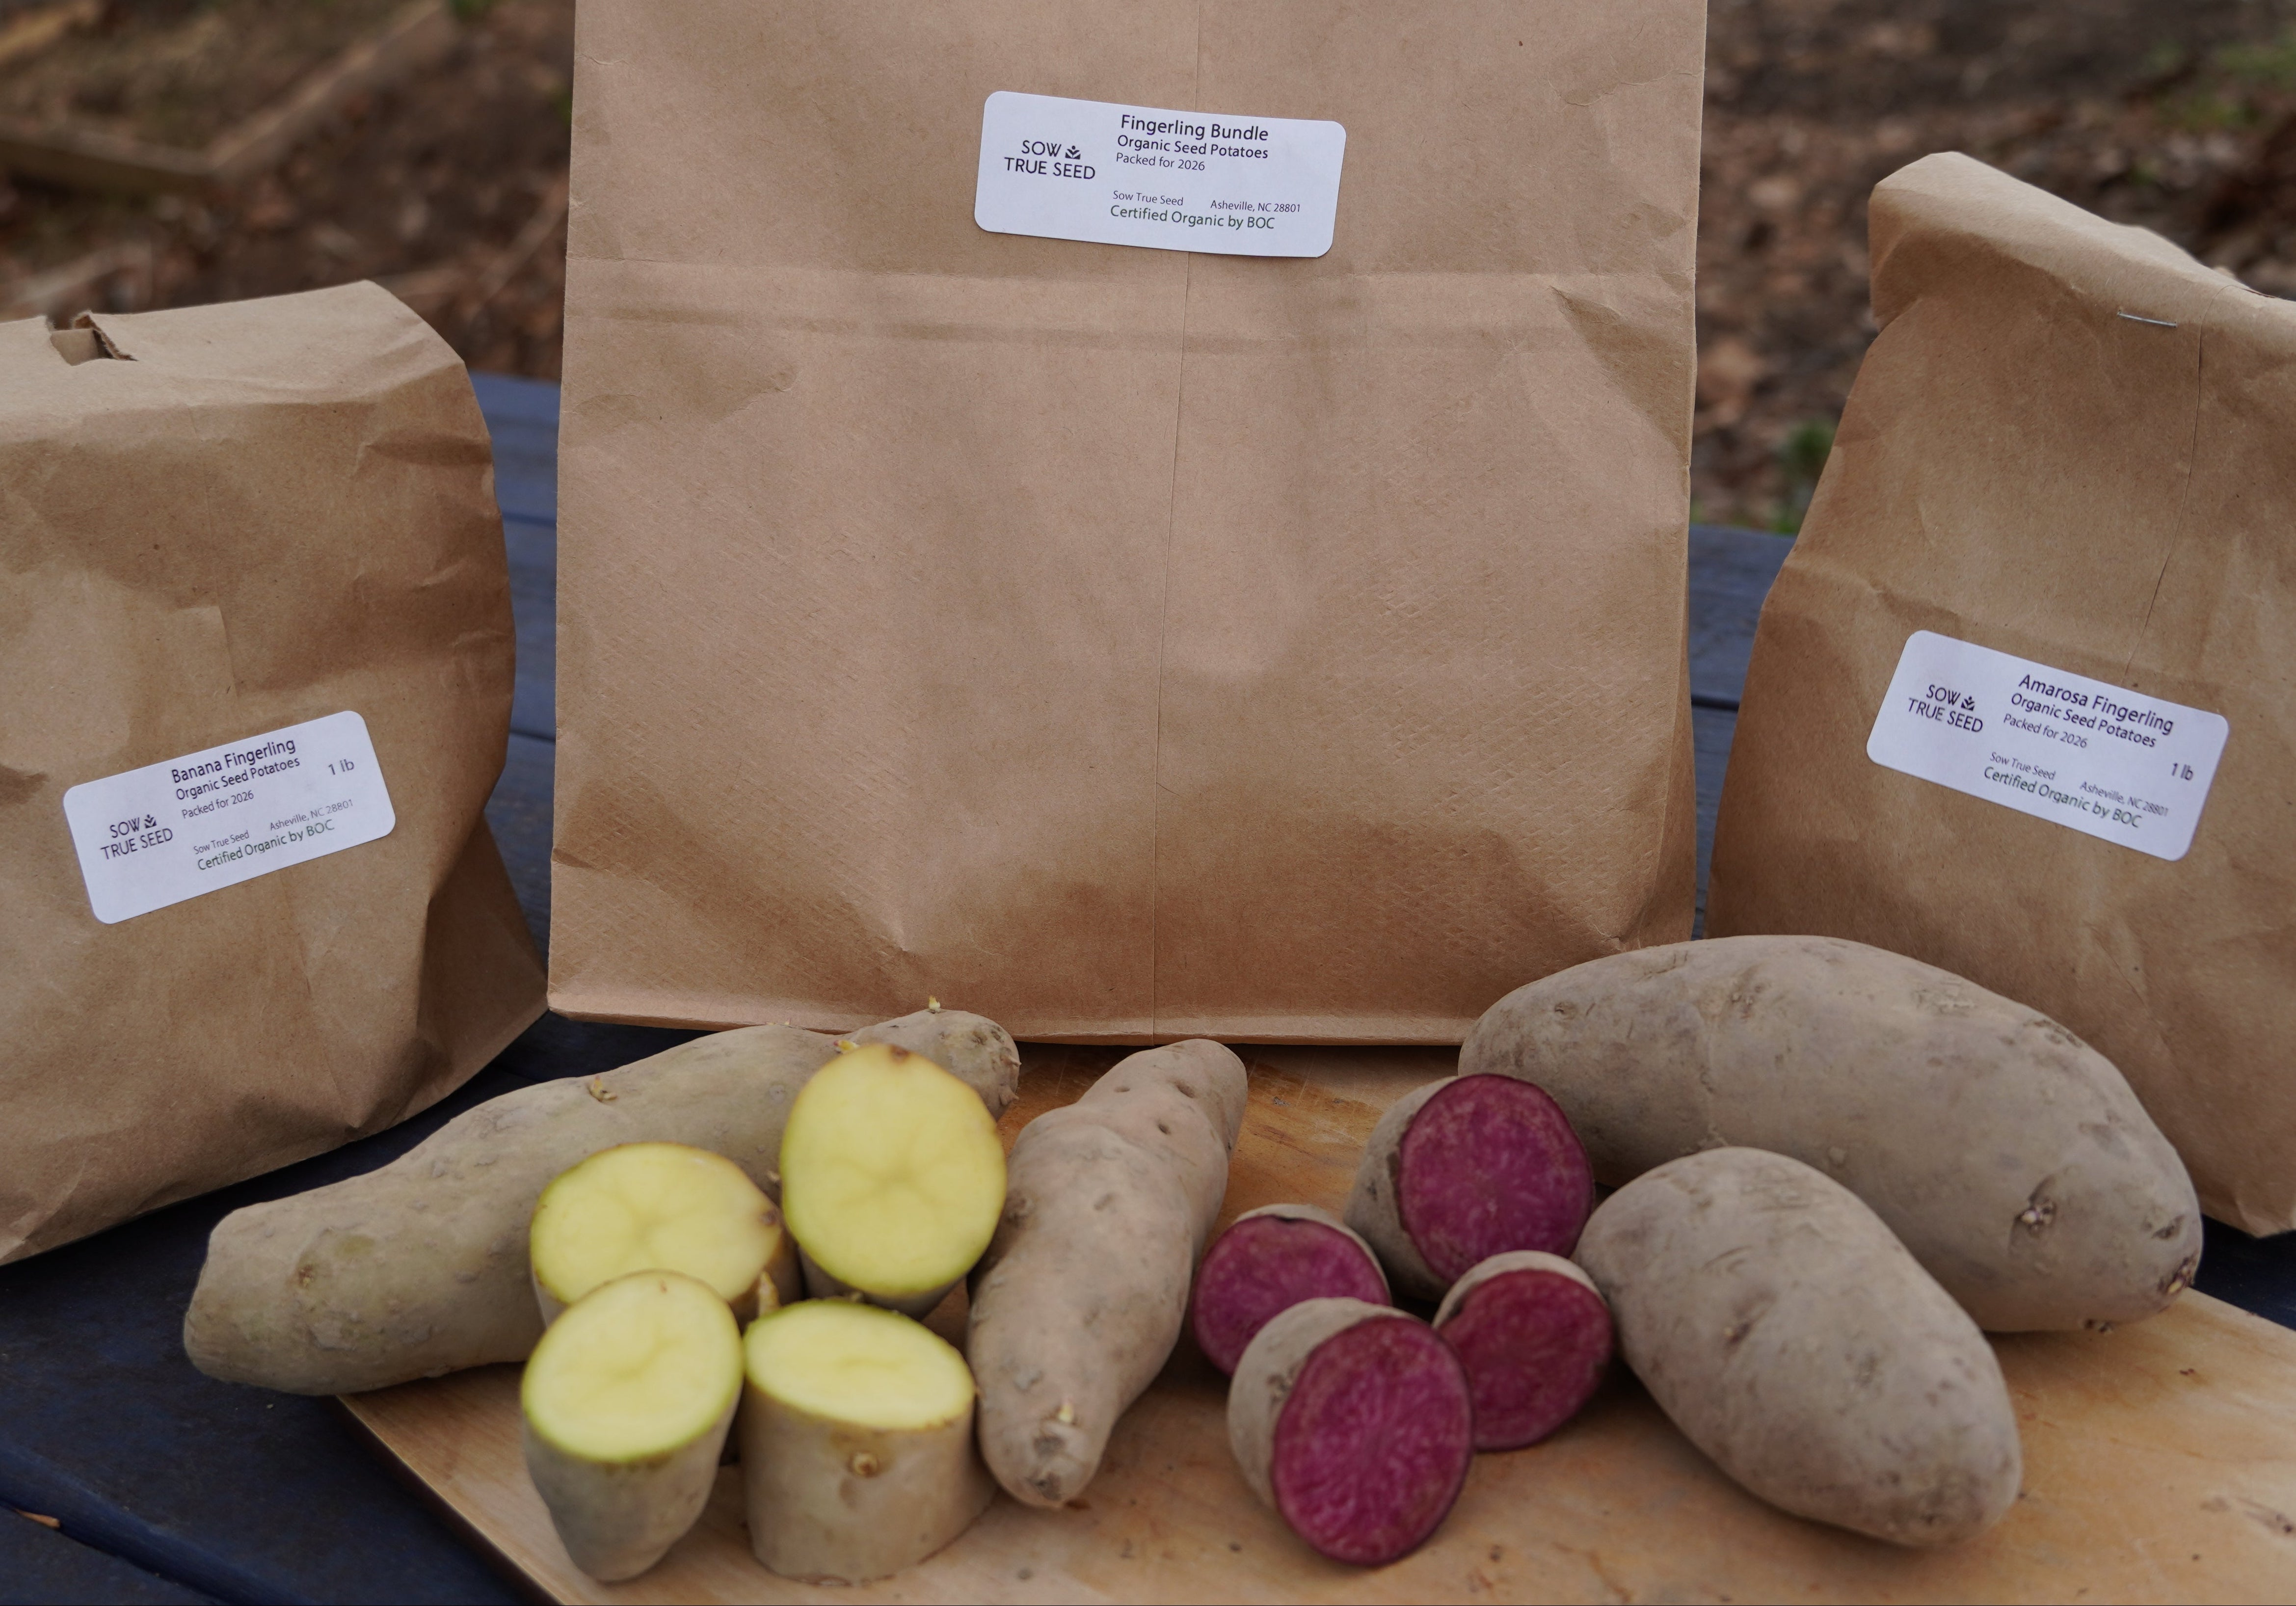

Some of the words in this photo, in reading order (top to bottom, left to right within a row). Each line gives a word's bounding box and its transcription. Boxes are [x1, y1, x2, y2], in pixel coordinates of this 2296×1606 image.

[1121, 114, 1205, 141] Fingerling
[1210, 123, 1269, 141] Bundle
[1021, 139, 1062, 158] SOW
[1117, 134, 1171, 152] Organic
[1174, 140, 1207, 155] Seed
[1210, 143, 1268, 159] Potatoes
[1004, 157, 1048, 175] TRUE
[1052, 161, 1096, 180] SEED
[1116, 152, 1156, 166] Packed
[1159, 156, 1175, 168] for
[1177, 159, 1205, 171] 2026
[1113, 190, 1134, 201] Sow
[1135, 192, 1158, 204] True
[1159, 195, 1184, 206] Seed
[1210, 199, 1255, 213] Asheville,
[1257, 202, 1272, 213] NC
[1273, 203, 1301, 213] 28801
[1110, 205, 1168, 222] Certified
[1171, 211, 1225, 228] Organic
[1228, 214, 1244, 231] by
[1247, 216, 1275, 229] BOC
[1925, 684, 1961, 706] SOW
[2018, 673, 2088, 707] Amarosa
[2091, 695, 2174, 736] Fingerling
[1908, 697, 1946, 722] TRUE
[1947, 710, 1983, 733] SEED
[2011, 692, 2062, 719] Organic
[2062, 708, 2097, 729] Seed
[2097, 719, 2157, 748] Potatoes
[2003, 713, 2042, 734] Packed
[2042, 724, 2059, 739] for
[2059, 731, 2088, 749] 2026
[171, 760, 223, 784] Banana
[224, 740, 296, 769] Fingerling
[328, 764, 336, 776] 1
[339, 759, 355, 773] lb
[1990, 751, 2010, 765] Sow
[2011, 757, 2031, 773] True
[2032, 765, 2056, 780] Seed
[2171, 762, 2179, 776] 1
[2180, 764, 2193, 781] lb
[176, 779, 220, 801] Organic
[221, 769, 249, 788] Seed
[249, 758, 300, 779] Potatoes
[182, 801, 215, 819] Packed
[216, 798, 230, 809] for
[230, 790, 254, 805] 2026
[1984, 766, 2038, 794] Certified
[2038, 784, 2090, 811] Organic
[2091, 801, 2110, 819] by
[2112, 808, 2143, 828] BOC
[2080, 781, 2125, 805] Asheville,
[2127, 796, 2143, 809] NC
[2142, 801, 2169, 816] 28801
[109, 817, 140, 839] SOW
[270, 813, 309, 831] Asheville,
[310, 807, 325, 819] NC
[325, 799, 353, 814] 28801
[100, 838, 138, 860] TRUE
[139, 828, 173, 849] SEED
[193, 844, 210, 855] Sow
[211, 837, 230, 849] True
[230, 830, 250, 843] Seed
[197, 846, 243, 870] Certified
[244, 835, 288, 855] Organic
[288, 830, 304, 843] by
[306, 819, 335, 837] BOC
